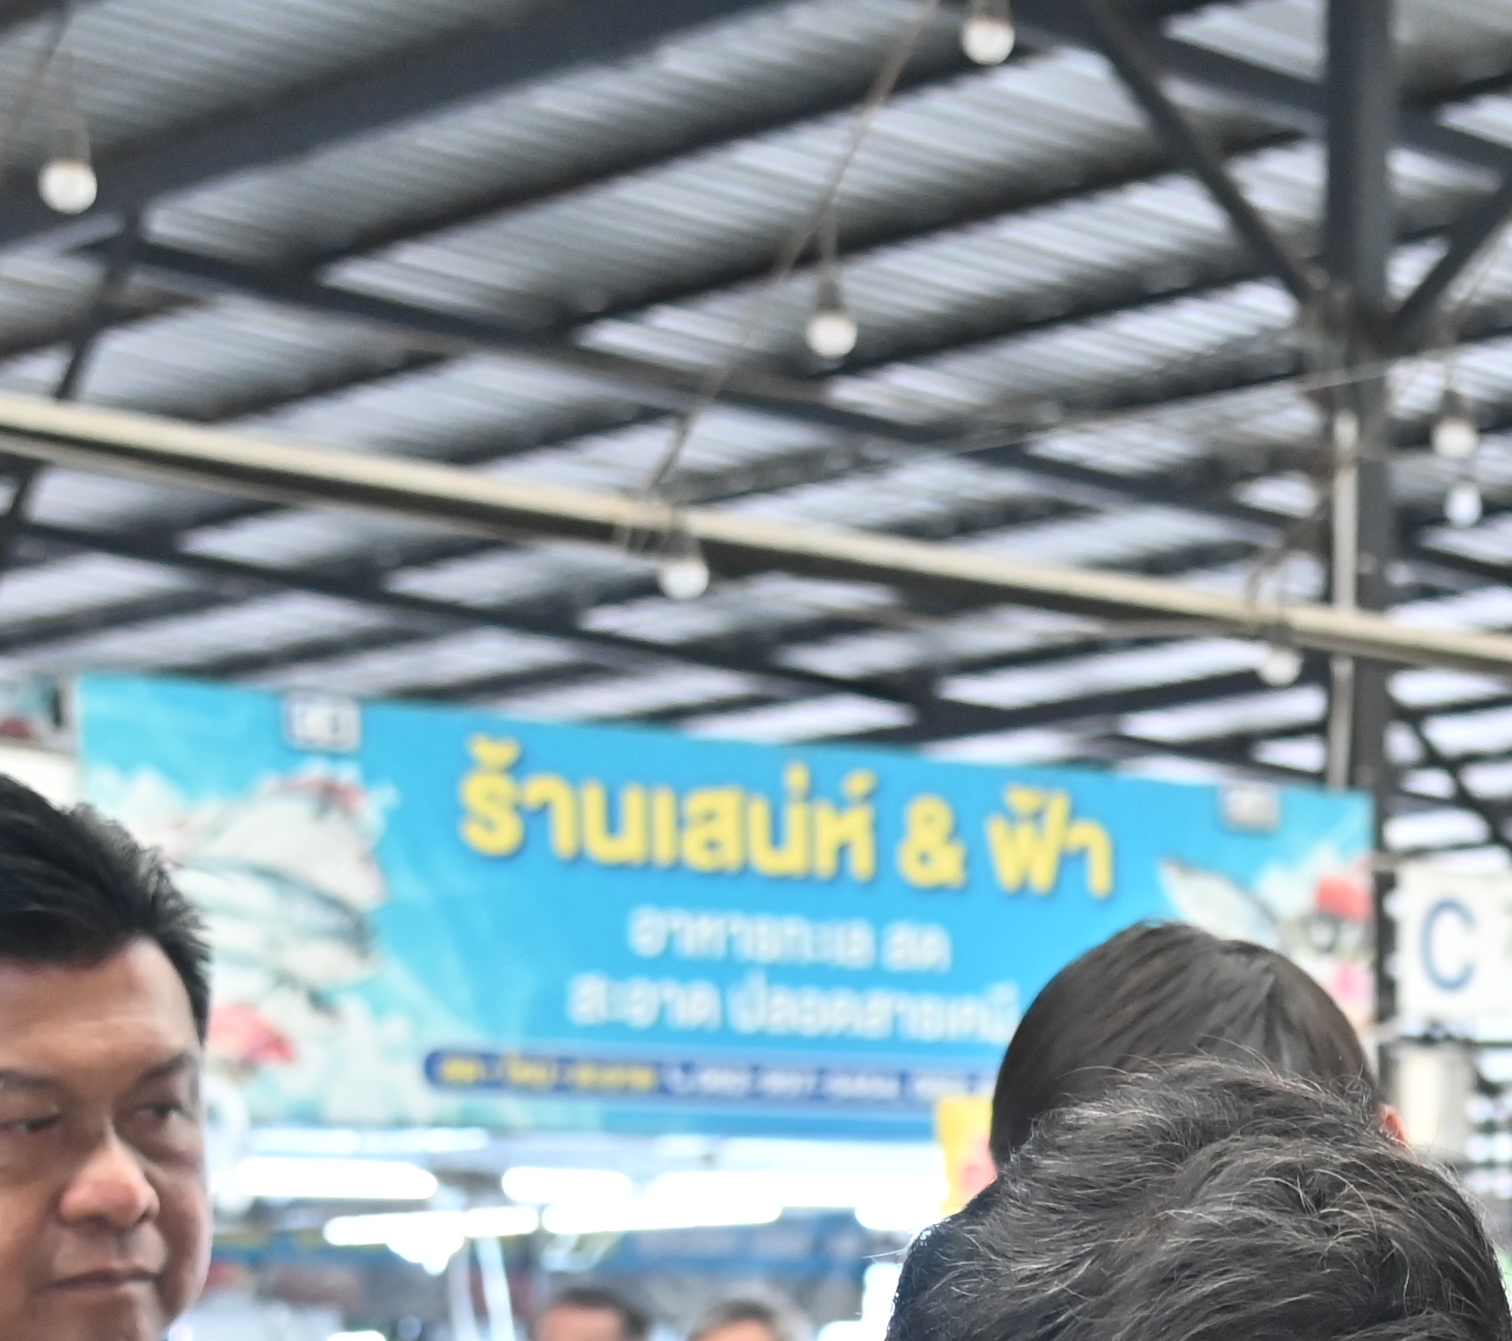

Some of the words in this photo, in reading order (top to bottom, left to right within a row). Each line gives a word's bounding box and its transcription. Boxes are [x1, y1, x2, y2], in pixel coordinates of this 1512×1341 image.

[462, 734, 879, 883] ร้านเสน่ห์
[898, 794, 968, 889] &
[988, 785, 1113, 898] ฟ้า
[1420, 900, 1477, 991] C
